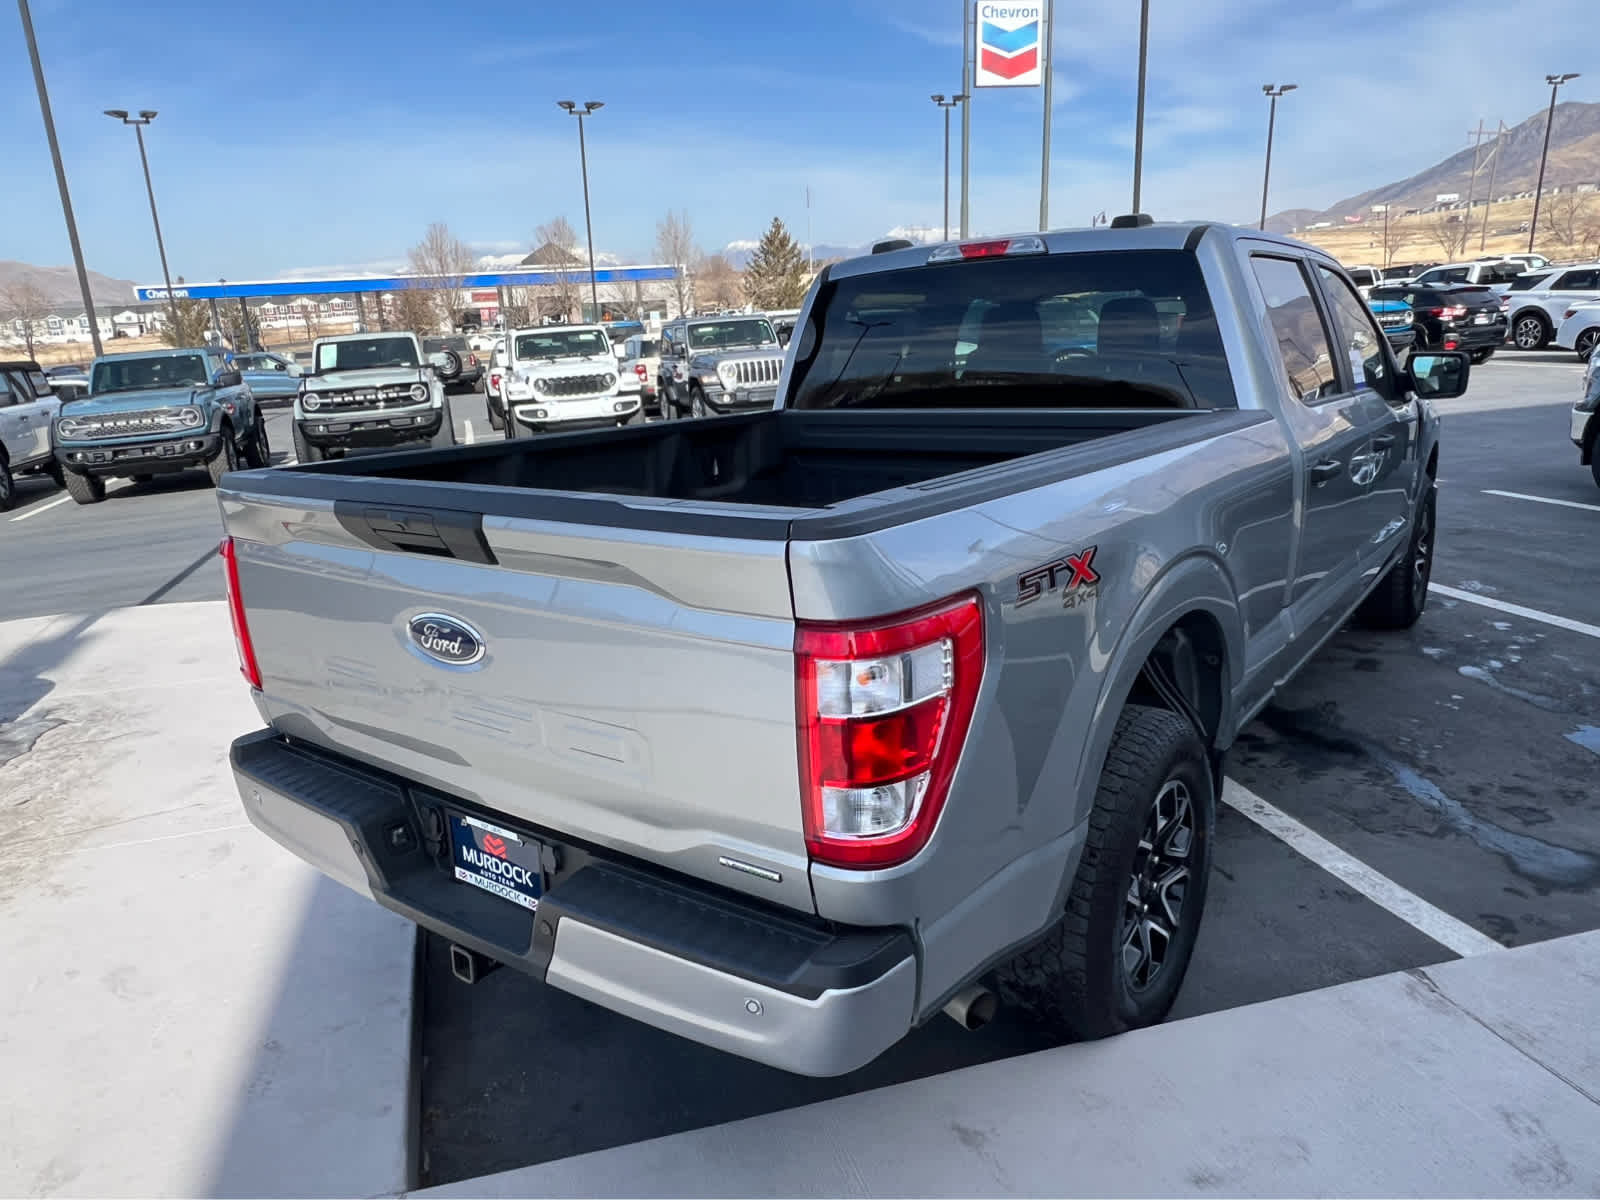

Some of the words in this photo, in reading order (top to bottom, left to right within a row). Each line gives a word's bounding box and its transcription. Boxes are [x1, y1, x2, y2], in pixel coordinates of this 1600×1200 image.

[981, 5, 1038, 18] Chevron
[1015, 544, 1101, 608] STX
[421, 623, 462, 655] Ford
[462, 845, 533, 888] MURDOCK
[480, 869, 497, 880] AUTO
[498, 875, 515, 888] TEAM
[474, 875, 521, 901] MURDOCK
